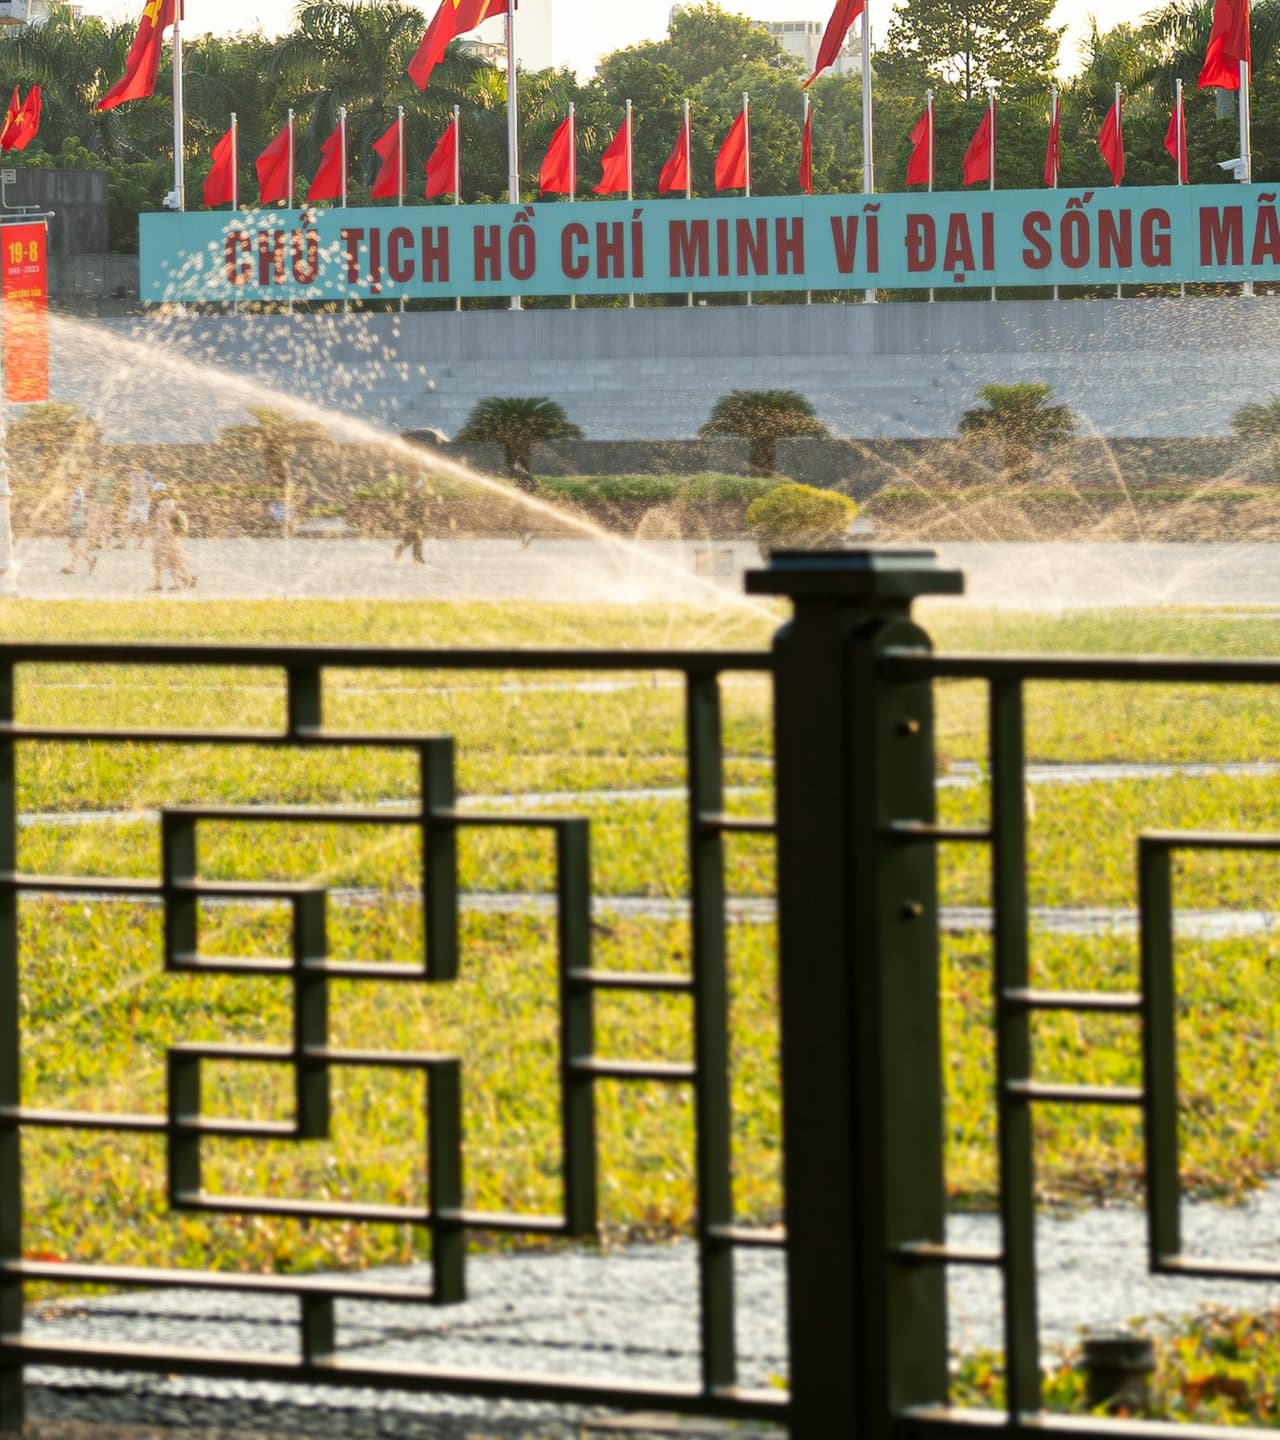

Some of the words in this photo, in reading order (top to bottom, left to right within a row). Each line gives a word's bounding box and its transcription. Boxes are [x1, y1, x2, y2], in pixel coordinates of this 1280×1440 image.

[340, 225, 450, 295] TỊCH
[473, 206, 537, 282] HỒ
[560, 207, 644, 280] CHÍ
[668, 216, 806, 278] MINH
[829, 202, 882, 275] VĨ
[904, 211, 995, 284] ĐẠI
[1021, 191, 1172, 270] SỐNG
